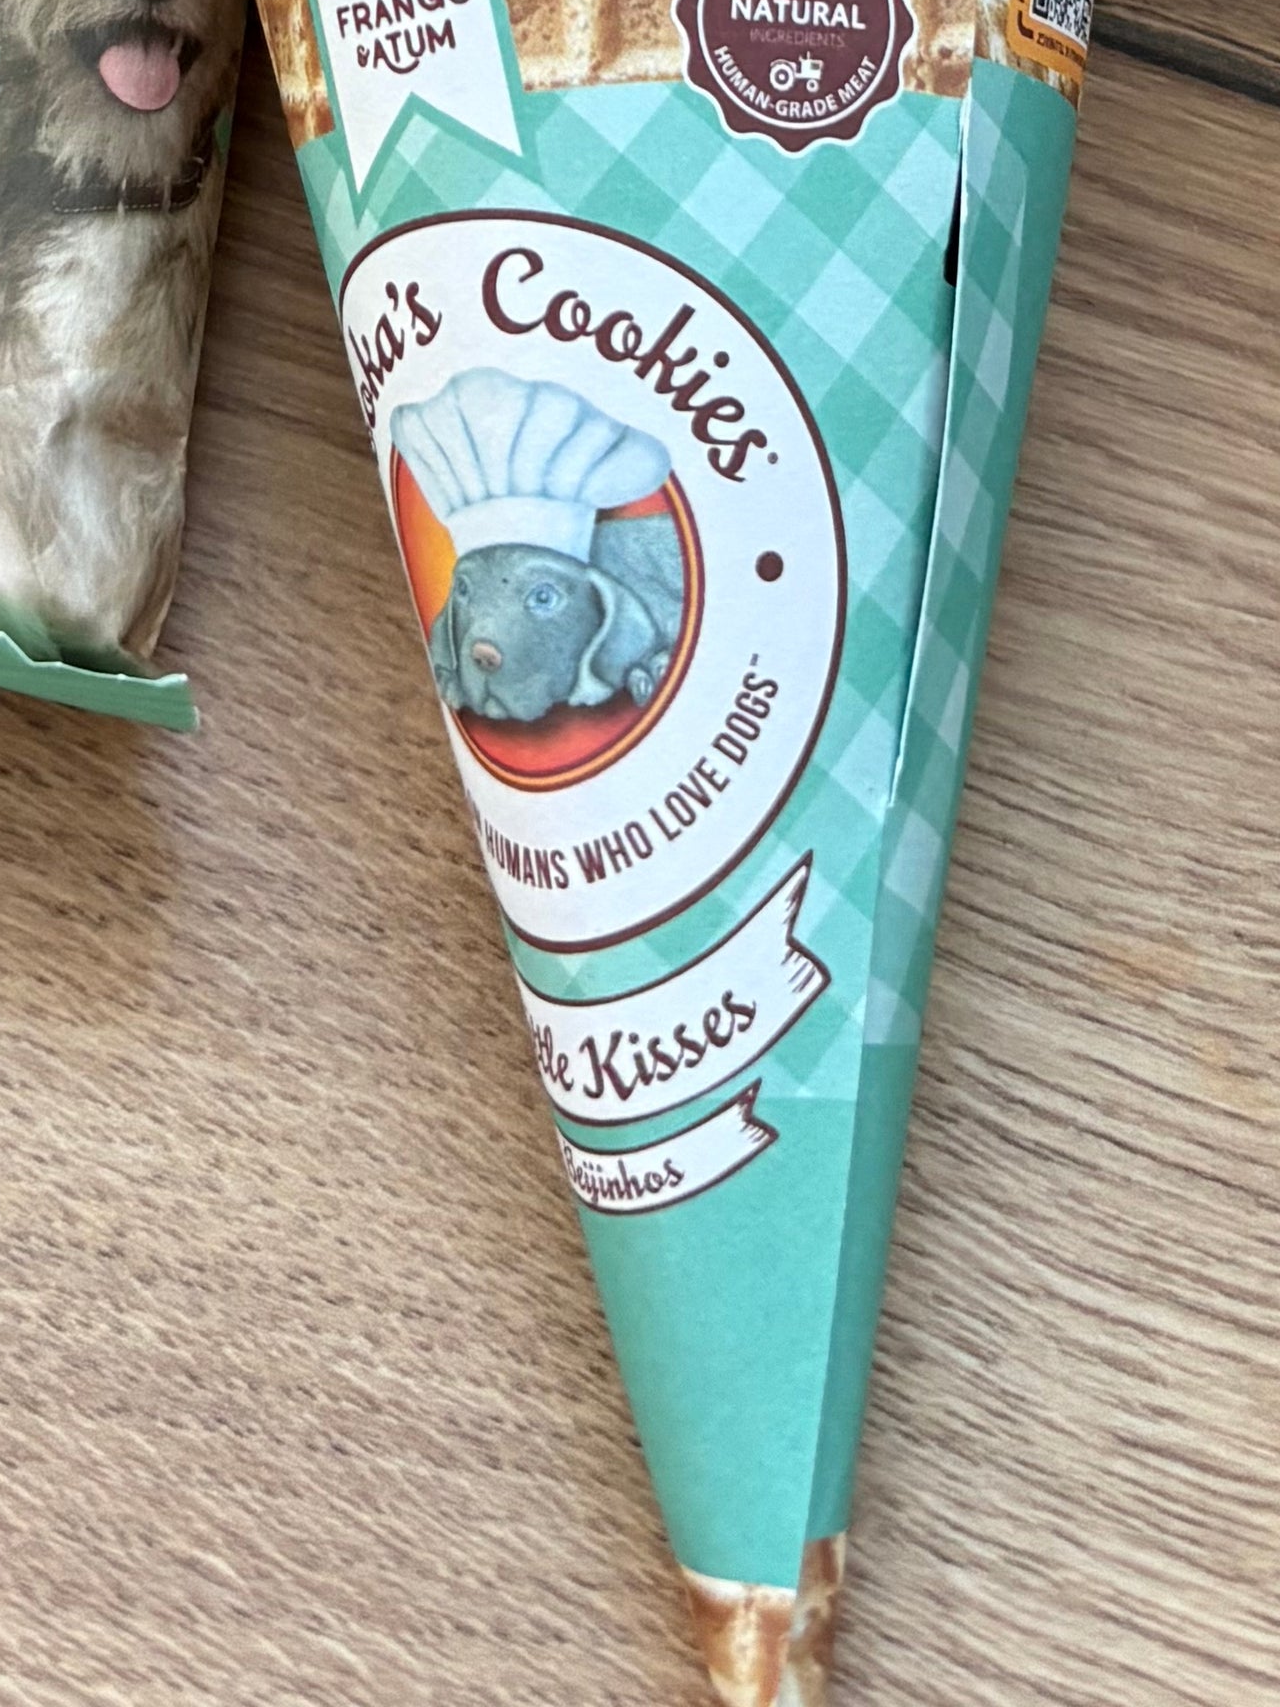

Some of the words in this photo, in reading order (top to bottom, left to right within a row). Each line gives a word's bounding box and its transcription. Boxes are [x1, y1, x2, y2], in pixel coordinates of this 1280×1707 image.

[713, 45, 839, 119] HUMAN-GRADE
[838, 55, 877, 105] MEAT
[749, 27, 846, 49] INGREDIENTS
[481, 247, 768, 483] Cookies
[484, 818, 570, 890] HUMANS
[573, 821, 653, 884] WHO
[649, 755, 730, 841] LOVE
[579, 989, 758, 1101] Kisses
